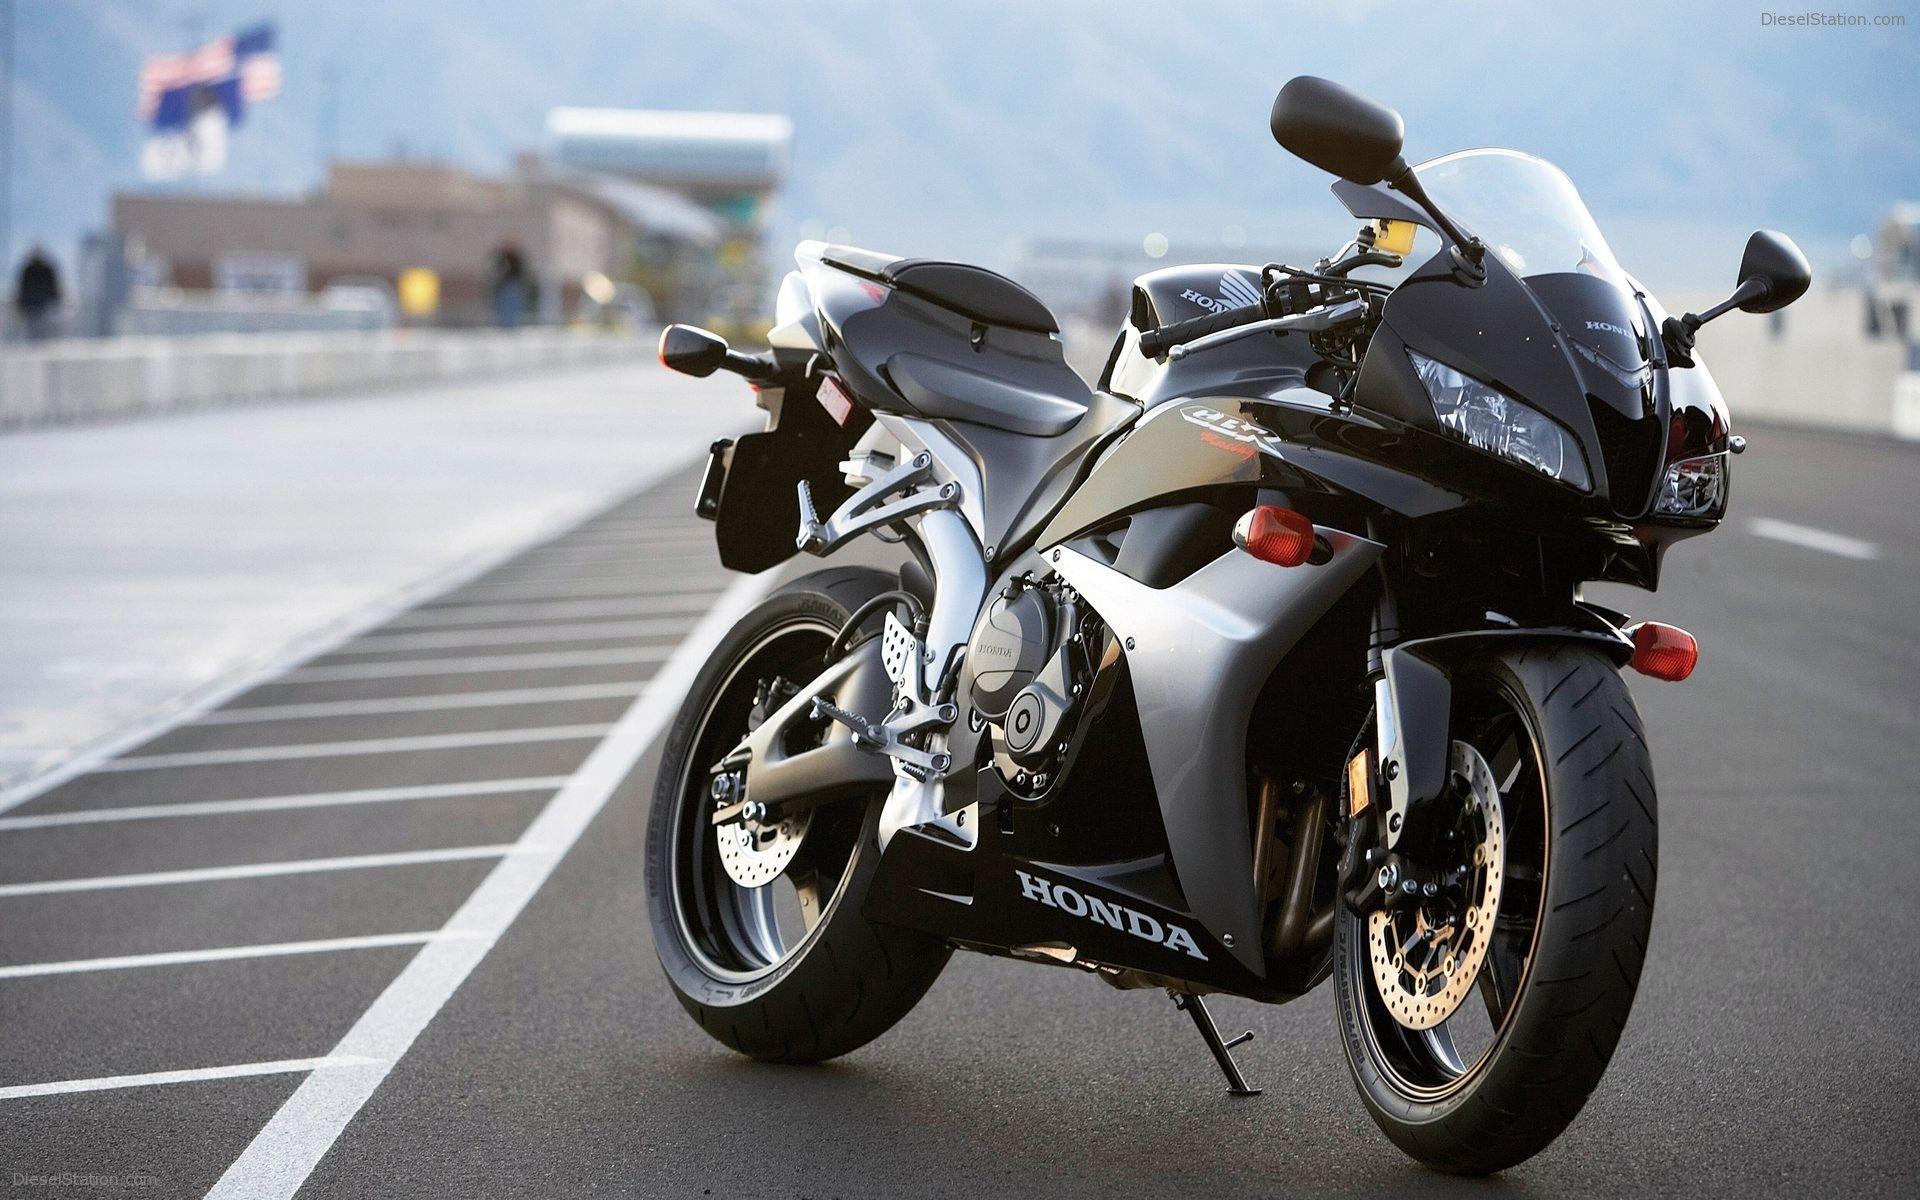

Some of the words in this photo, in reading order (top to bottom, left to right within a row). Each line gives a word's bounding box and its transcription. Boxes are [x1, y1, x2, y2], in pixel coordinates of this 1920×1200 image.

[1180, 288, 1229, 314] HON
[1585, 320, 1637, 340] HOND
[979, 643, 1013, 658] HONDA
[1015, 869, 1209, 962] HONDA
